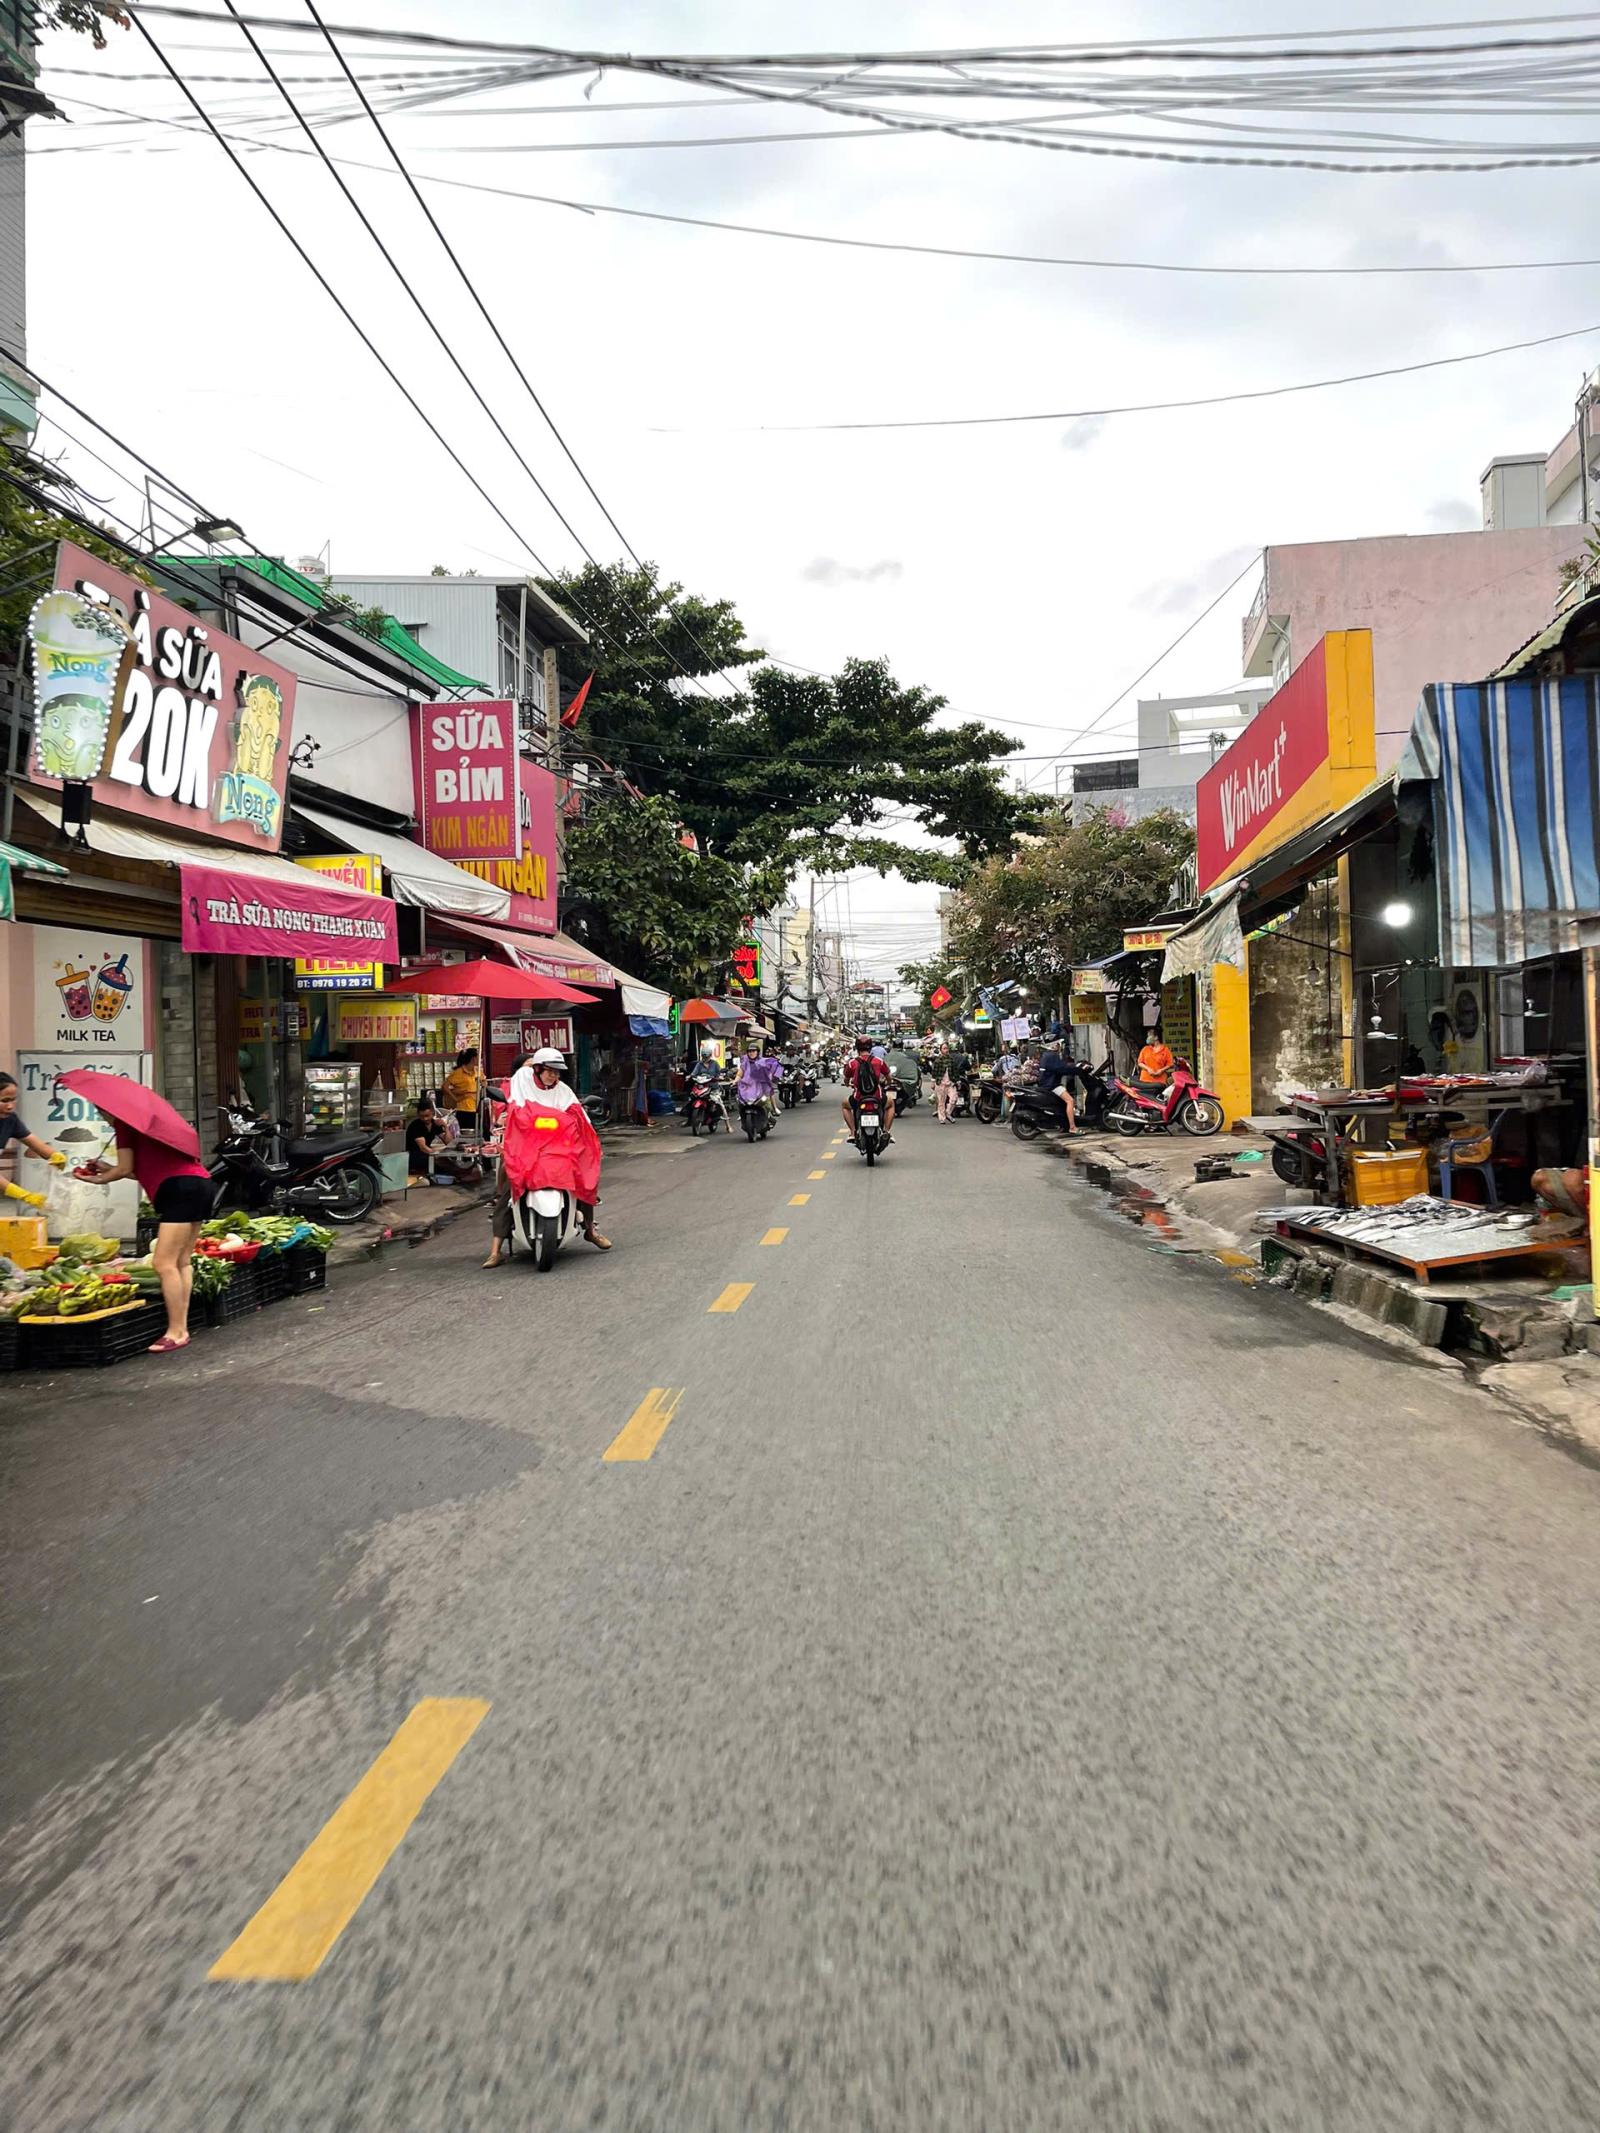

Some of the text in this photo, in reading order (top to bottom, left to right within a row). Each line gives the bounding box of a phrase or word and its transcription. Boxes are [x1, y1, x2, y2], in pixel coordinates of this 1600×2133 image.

[157, 627, 222, 700] SỮA
[431, 709, 504, 751] SỮA
[435, 757, 504, 803] BỈM
[431, 815, 461, 850] KIM
[467, 807, 509, 848] NGÂN
[207, 897, 386, 940] TRÀ SỮA NỌNG THẠNH XUÂN
[312, 979, 334, 988] 0976
[336, 979, 347, 987] 19
[348, 978, 359, 987] 20
[361, 978, 372, 986] 21
[57, 1030, 116, 1041] MILK TEA
[525, 1025, 543, 1050] SỮA
[549, 1022, 568, 1049] BỈM
